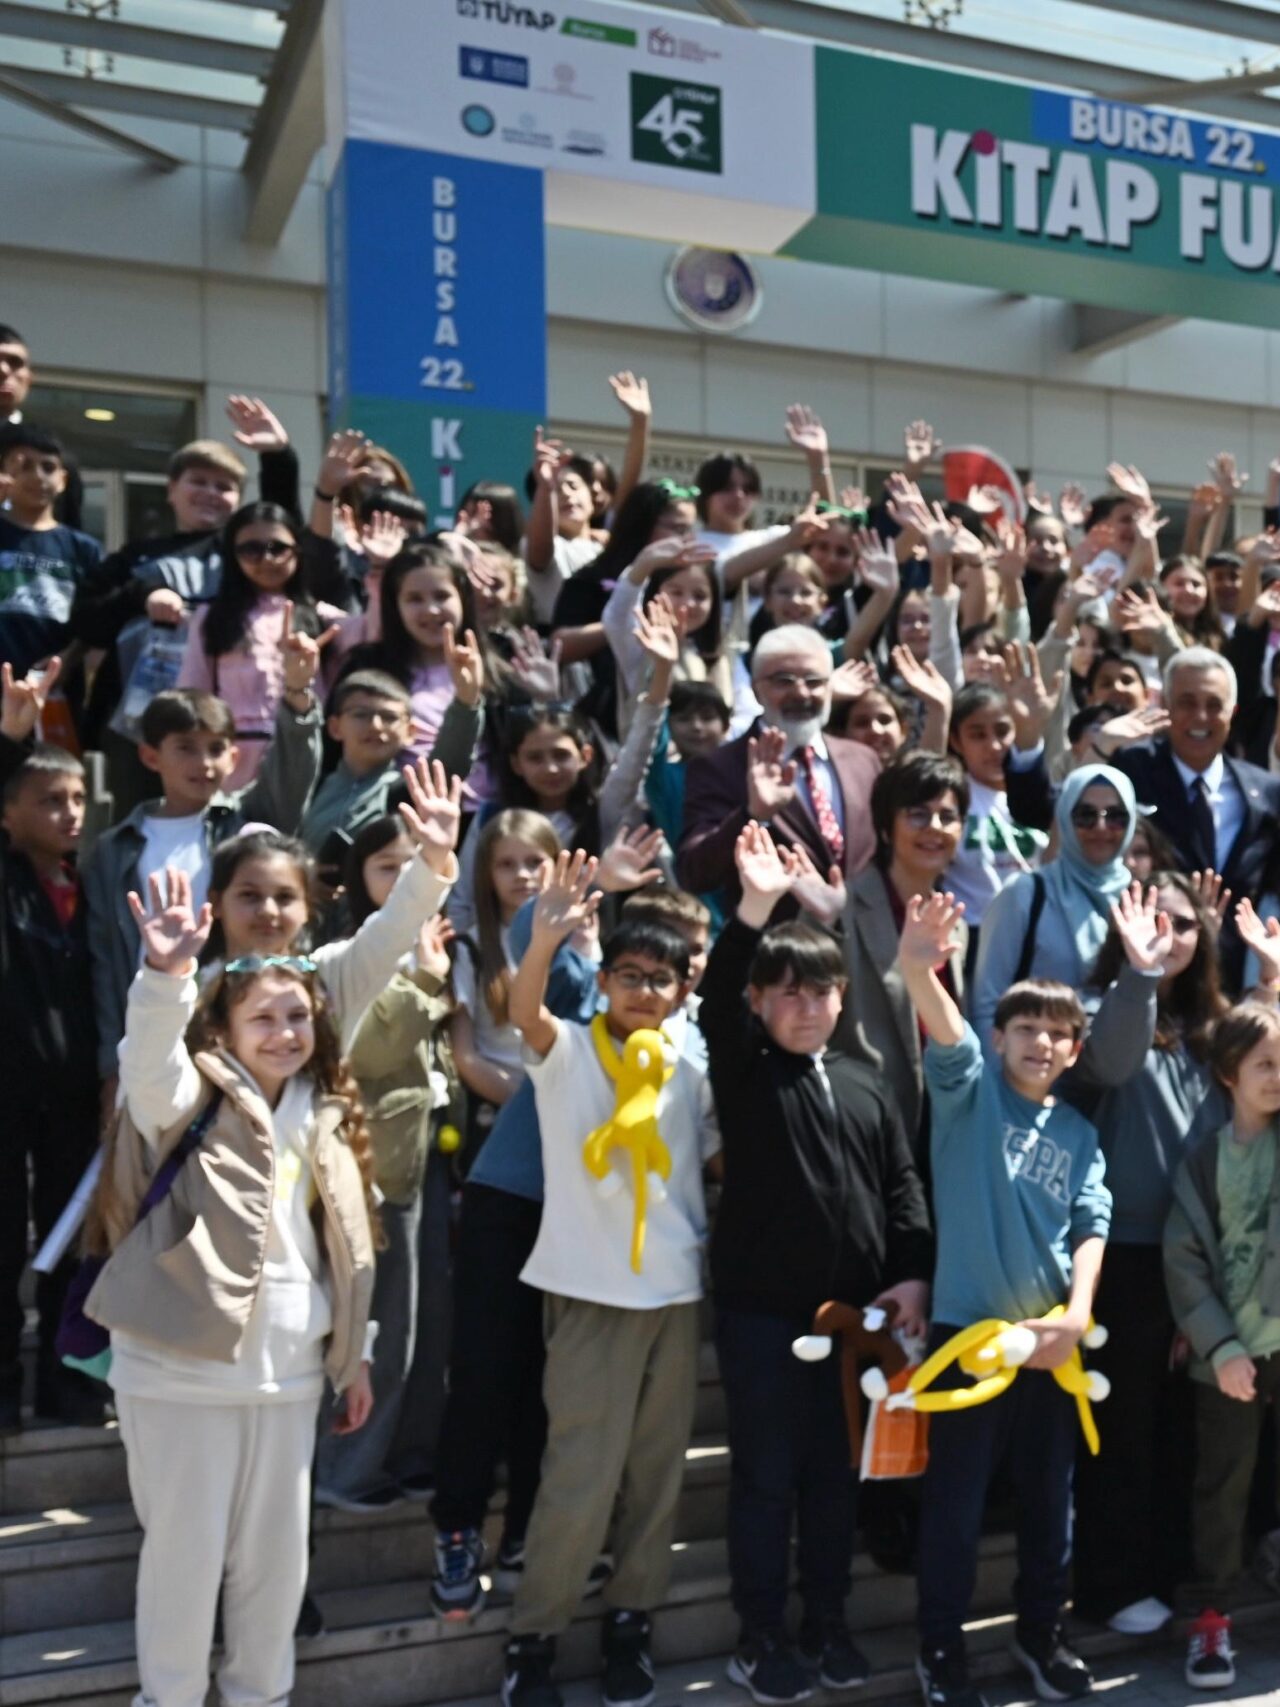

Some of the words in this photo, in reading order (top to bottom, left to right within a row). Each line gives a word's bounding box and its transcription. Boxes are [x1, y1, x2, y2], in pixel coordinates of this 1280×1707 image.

[483, 0, 556, 31] TÜYAP
[637, 94, 706, 158] 45
[1069, 98, 1194, 161] BURSA
[910, 122, 1160, 248] KİTAP
[432, 175, 460, 348] BURSA
